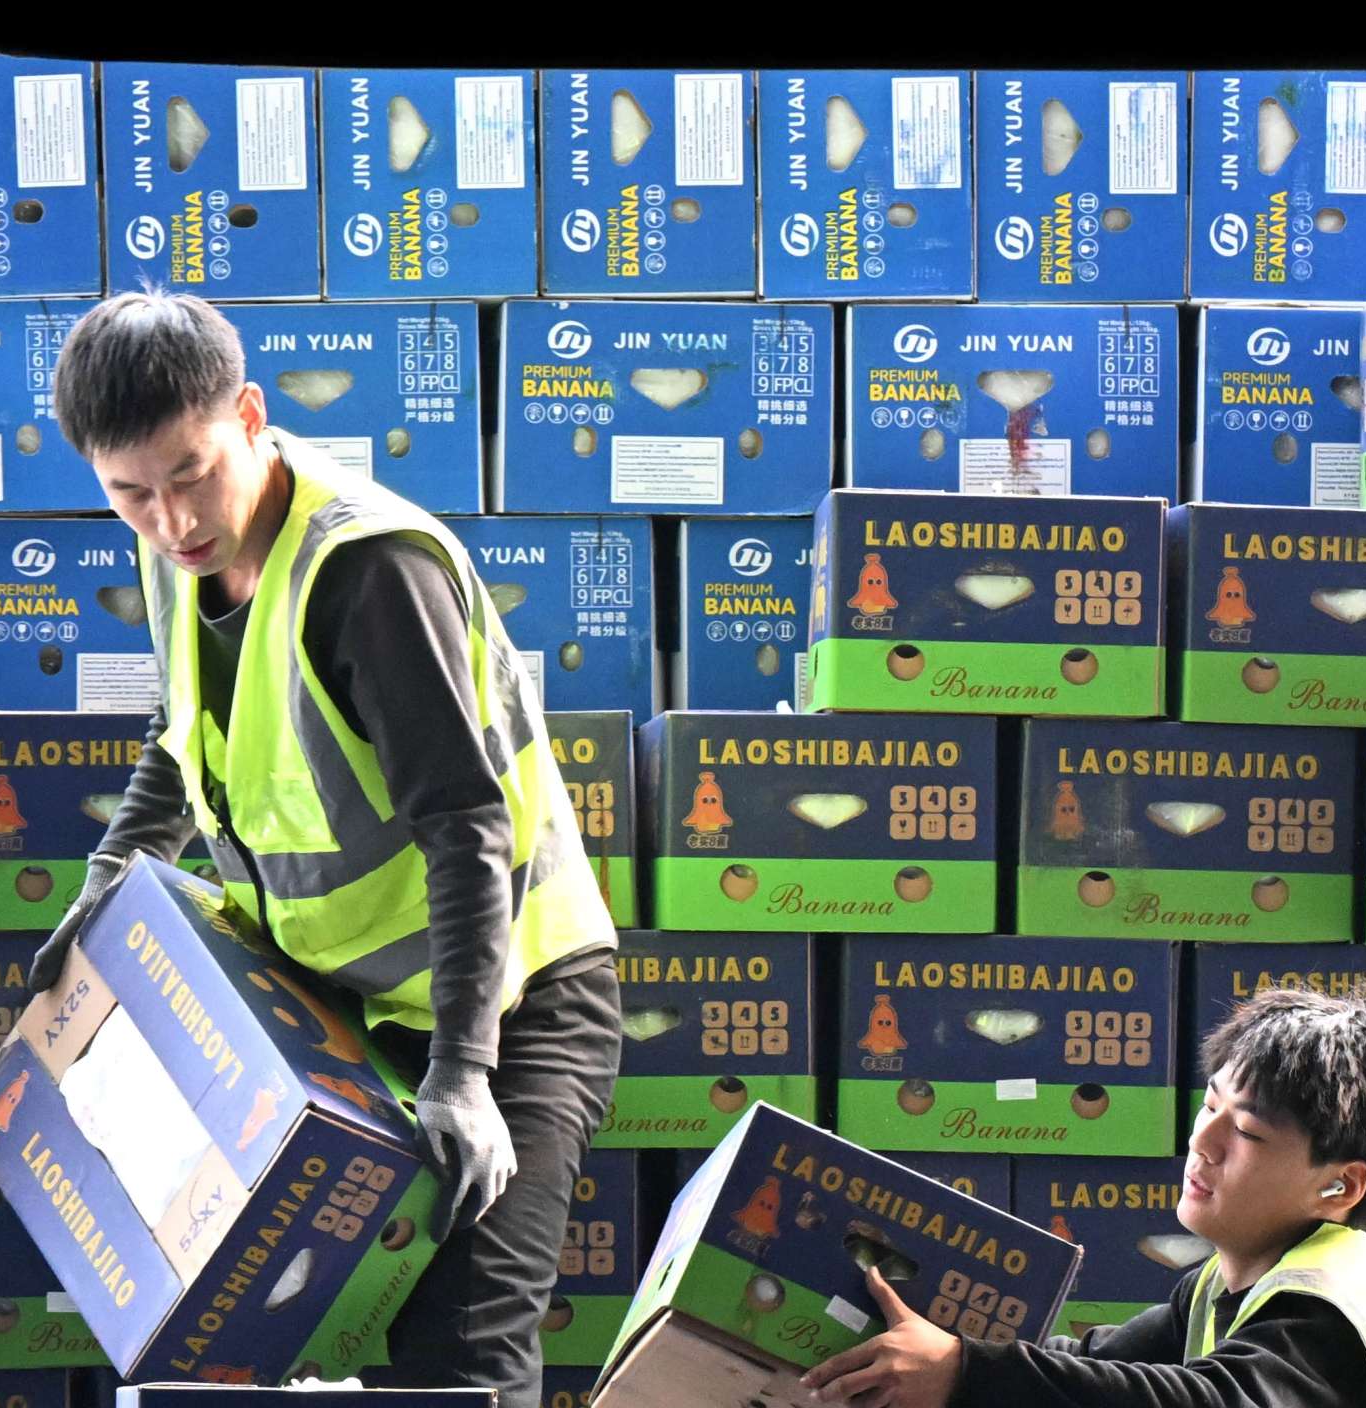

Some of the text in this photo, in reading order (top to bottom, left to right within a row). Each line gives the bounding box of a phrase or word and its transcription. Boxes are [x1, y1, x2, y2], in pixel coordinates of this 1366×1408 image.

[132, 80, 151, 192] JIN YUAN
[352, 78, 370, 190] JIN YUAN
[571, 73, 589, 186] JIN YUAN
[788, 78, 807, 190] JIN YUAN
[1005, 80, 1022, 193] JIN YUAN
[1222, 78, 1240, 190] JIN YUAN
[172, 214, 184, 282] PREMIUM
[187, 191, 205, 282] BANANA
[389, 211, 403, 280] PREMIUM
[404, 188, 421, 280] BANANA
[607, 209, 620, 276] PREMIUM
[621, 185, 640, 276] BANANA
[827, 212, 840, 280] PREMIUM
[842, 188, 857, 280] BANANA
[1040, 216, 1054, 284] PREMIUM
[1054, 192, 1072, 285] BANANA
[1254, 214, 1267, 282] PREMIUM
[1269, 191, 1287, 282] BANANA
[260, 334, 373, 351] JIN YUAN
[523, 366, 591, 379] PREMIUM
[614, 332, 727, 350] JIN YUAN
[960, 334, 1073, 352] JIN YUAN
[1313, 338, 1350, 355] JIN
[522, 380, 614, 398] BANANA
[870, 369, 938, 382] PREMIUM
[870, 384, 961, 402] BANANA
[1222, 386, 1313, 404] BANANA
[1223, 372, 1290, 385] PREMIUM
[79, 550, 118, 567] JIN
[482, 547, 545, 564] YUAN
[865, 520, 1125, 551] LAOSHIBAJIAO
[705, 583, 773, 596] PREMIUM
[705, 597, 796, 615] BANANA
[931, 667, 1059, 700] Banana
[700, 739, 960, 767] LAOSHIBAJIAO
[1059, 748, 1320, 781] LAOSHIBAJIAO
[930, 791, 940, 806] 4
[958, 792, 968, 807] 5
[767, 883, 895, 917] Banana
[1123, 894, 1252, 927] Banana
[127, 919, 244, 1090] LAOSHIBAJIAO
[875, 961, 1136, 992] LAOSHIBAJIAO
[44, 979, 90, 1049] 52XY
[941, 1107, 1068, 1141] Banana
[21, 1131, 137, 1309] LAOSHIBAJIAO
[178, 1183, 224, 1254] 52XY
[772, 1144, 1029, 1276] LAOSHIBAJIAO
[170, 1155, 328, 1372] LAOSHIBAJIAO
[331, 1257, 412, 1367] Banana
